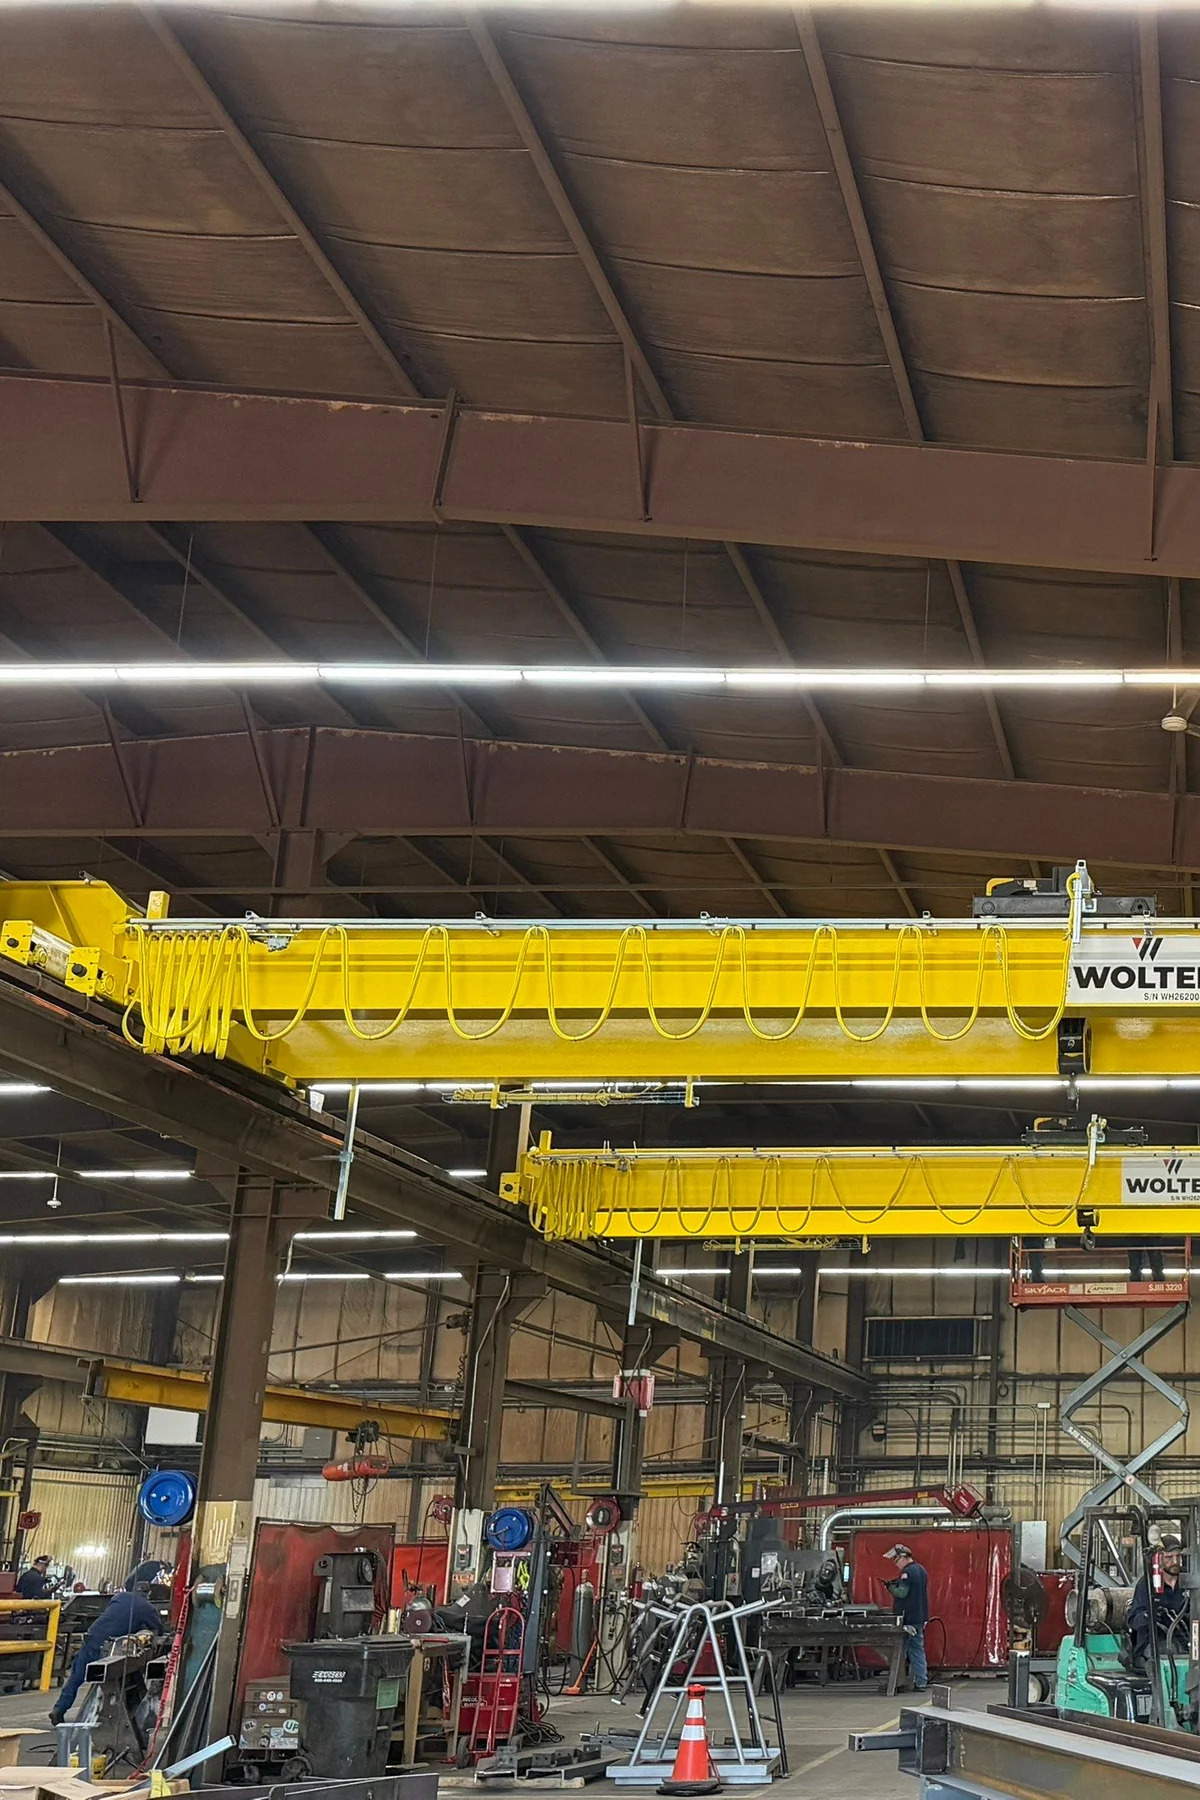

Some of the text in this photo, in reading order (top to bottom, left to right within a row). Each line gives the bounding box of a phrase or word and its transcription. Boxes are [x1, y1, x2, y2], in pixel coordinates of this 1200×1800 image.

[1143, 992, 1159, 1001] S/N
[1024, 1284, 1067, 1294] SKYJACK
[1165, 1283, 1183, 1292] 3220
[285, 1721, 299, 1731] UP
